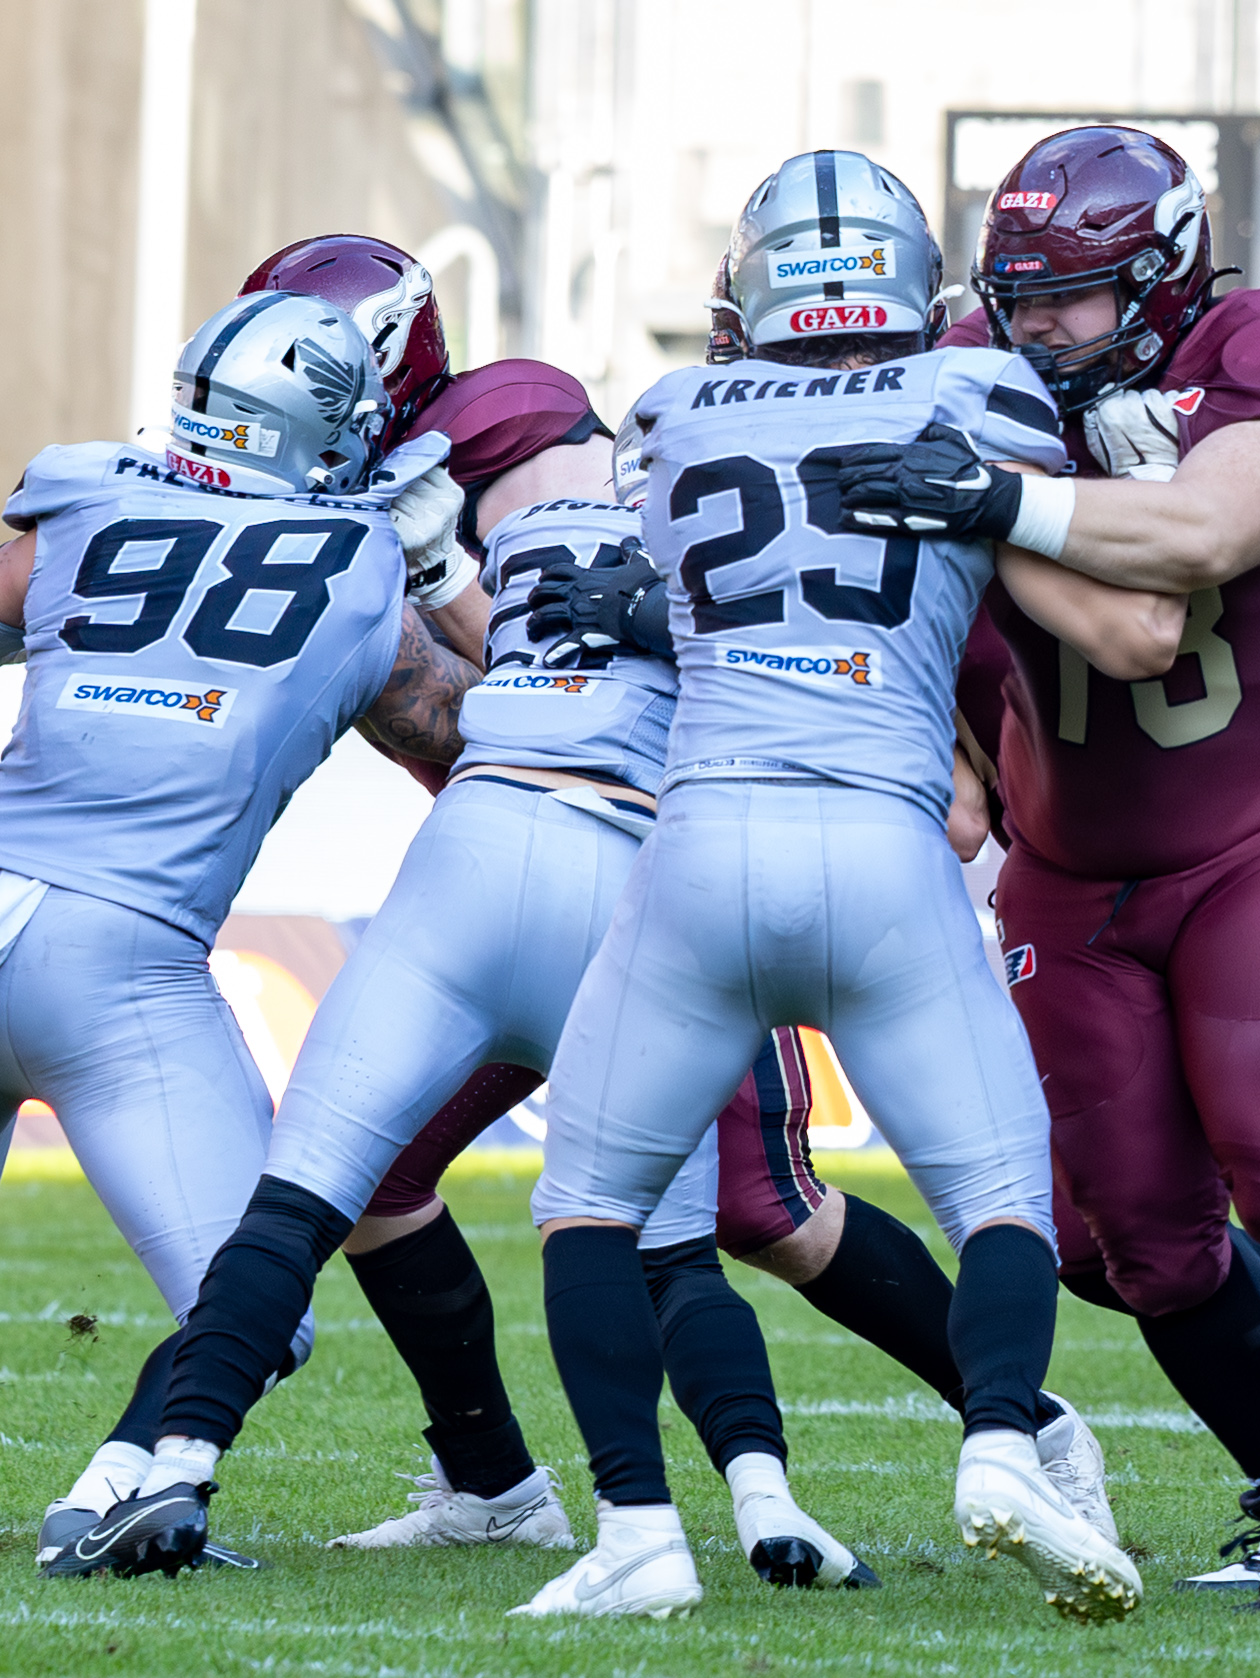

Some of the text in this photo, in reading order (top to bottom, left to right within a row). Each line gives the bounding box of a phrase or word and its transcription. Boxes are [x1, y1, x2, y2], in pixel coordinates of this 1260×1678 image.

[777, 256, 858, 278] swarco
[690, 367, 906, 410] KRIENER
[172, 409, 220, 439] warco
[57, 517, 372, 669] 98
[726, 648, 832, 675] swarco
[73, 682, 187, 709] swarco
